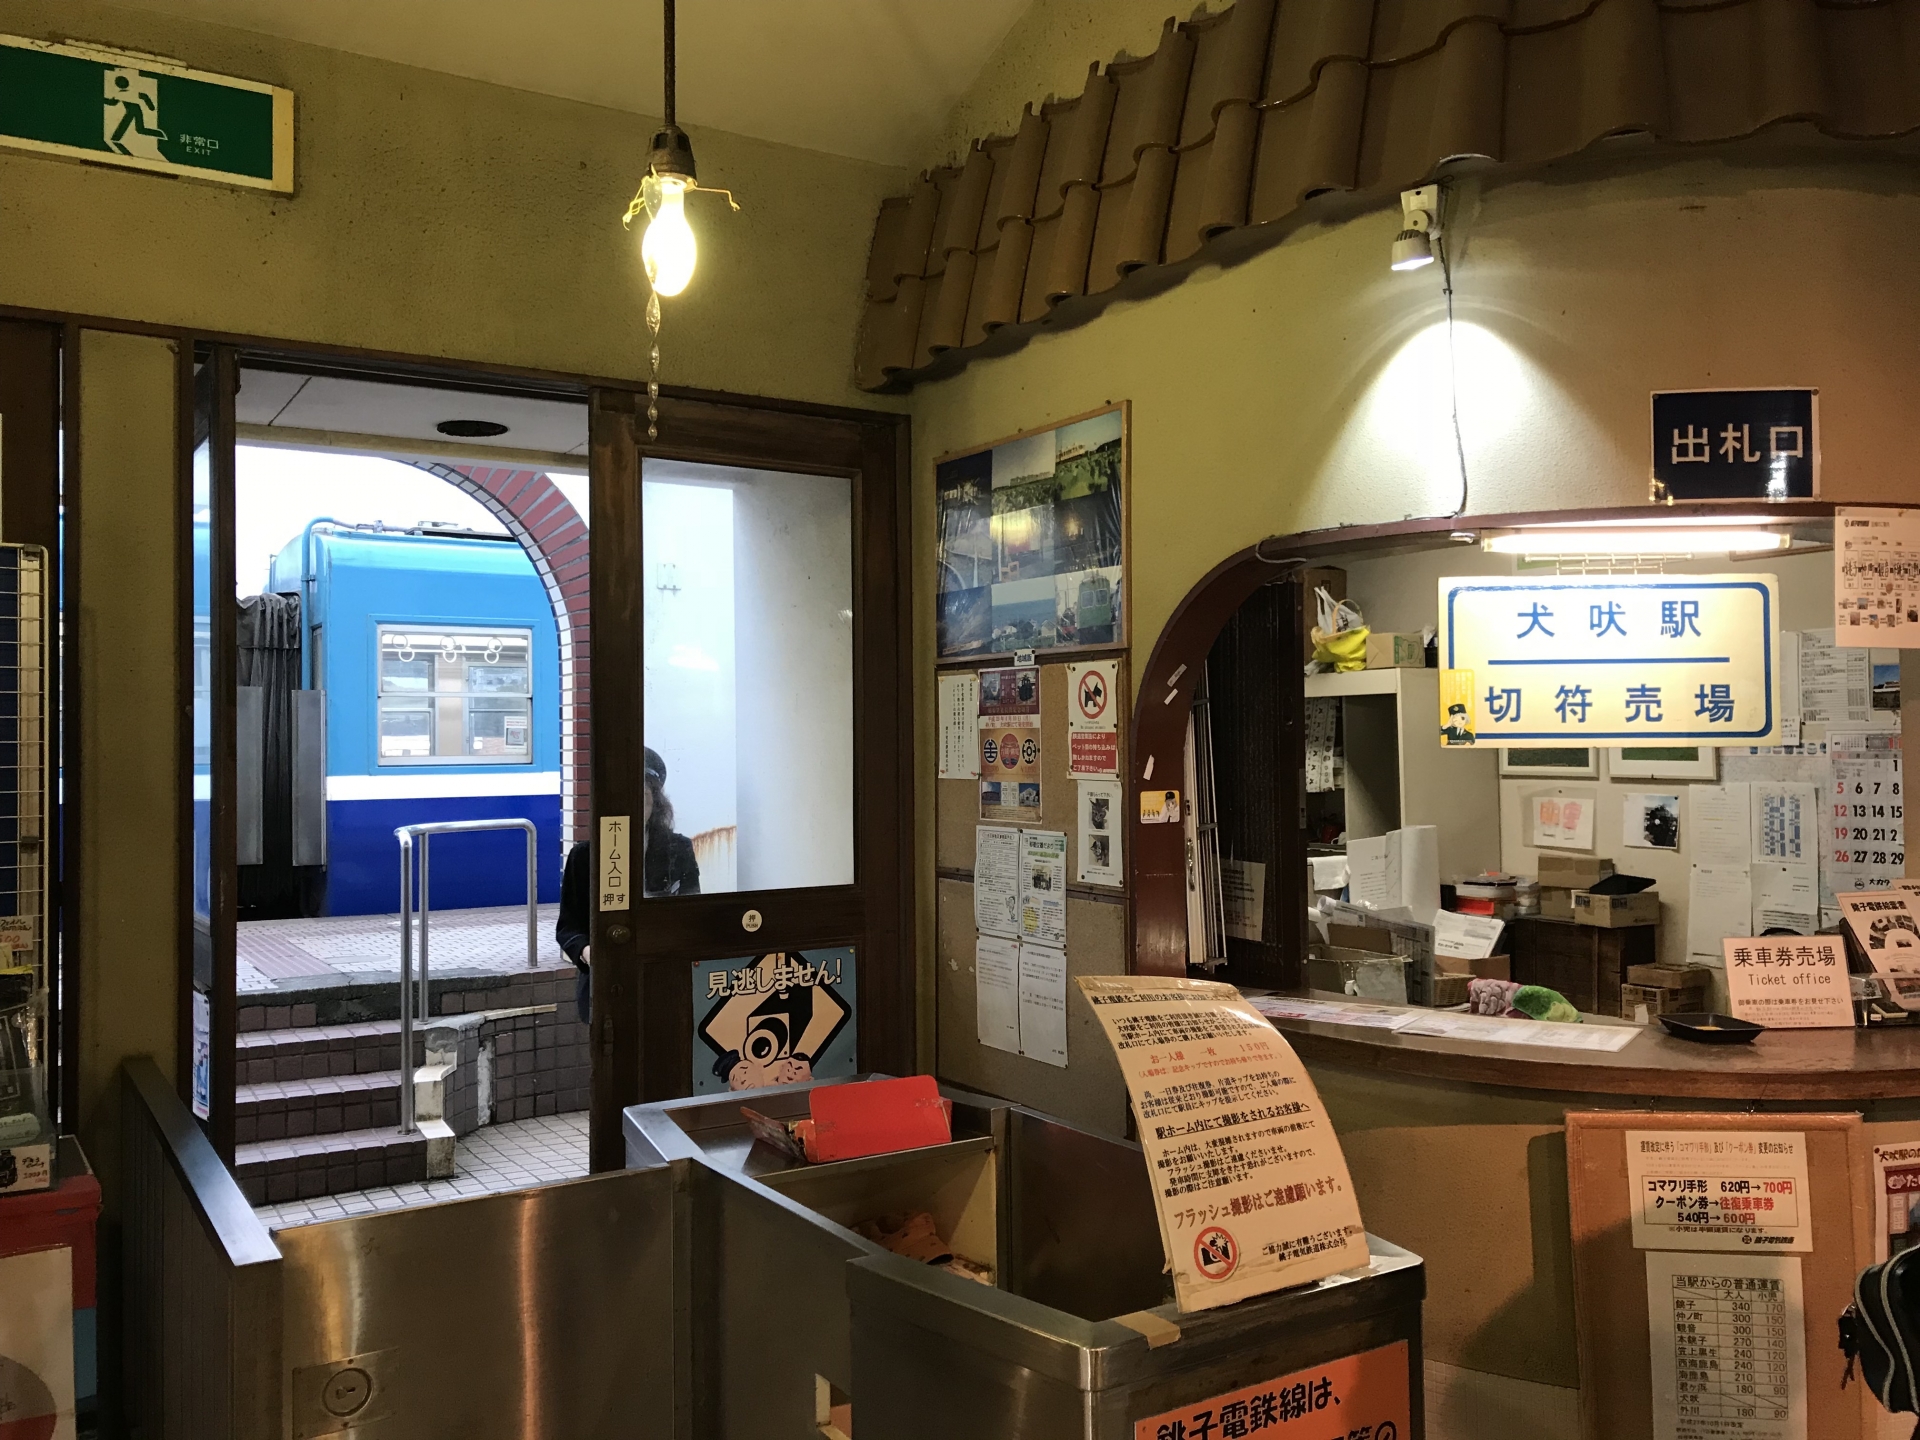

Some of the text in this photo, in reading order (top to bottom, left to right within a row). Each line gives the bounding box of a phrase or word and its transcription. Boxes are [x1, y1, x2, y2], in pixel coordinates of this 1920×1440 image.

[179, 134, 219, 149] 非常口
[186, 146, 212, 156] EXIT
[1671, 423, 1804, 464] 出札口
[1516, 601, 1702, 639] 犬吠駅
[1484, 684, 1735, 723] 切符売場
[1893, 759, 1898, 772] 1
[1836, 782, 1900, 795] 5 6 7 8
[1834, 804, 1903, 818] 12 13 14 15
[1834, 827, 1848, 839] 19
[1853, 828, 1868, 840] 20
[1872, 828, 1885, 841] 21
[608, 820, 623, 888] ホーム入口
[1834, 850, 1904, 865] 26 27 28 29
[602, 892, 626, 906] 押す
[748, 914, 757, 923] 押
[1733, 946, 1836, 967] 乗車券売場
[706, 958, 842, 999] 見逃しません!
[1748, 973, 1831, 986] Ticket office
[1150, 1041, 1270, 1065] お一人様 一枚 150円
[1155, 1101, 1311, 1140] 駅ホーム内にて撮影をされるお客様へ
[1879, 1148, 1920, 1162] 犬吠駅の
[1647, 1179, 1793, 1194] コマワリ手形 620円 700円
[1174, 1176, 1342, 1229] フラッシュ撮影はご遠慮願います。
[1655, 1195, 1774, 1211] クーポン券 往復乗車券
[1677, 1212, 1756, 1225] 540円 600円
[1676, 1276, 1781, 1292] 当駅からの普通運賃
[1724, 1290, 1744, 1300] 大人
[1732, 1302, 1750, 1311] 340
[1765, 1304, 1783, 1312] 170
[1732, 1314, 1750, 1323] 300
[1766, 1316, 1783, 1324] 150
[1733, 1326, 1751, 1335] 300
[1766, 1327, 1784, 1336] 150
[1733, 1338, 1751, 1347] 270
[1766, 1339, 1784, 1348] 140
[1734, 1350, 1752, 1358] 240
[1767, 1351, 1784, 1360] 120
[1734, 1361, 1752, 1370] 240
[1767, 1363, 1785, 1372] 120
[1734, 1373, 1753, 1382] 210
[1768, 1375, 1785, 1384] 110
[1736, 1385, 1753, 1394] 180
[1773, 1386, 1786, 1395] 90
[1736, 1408, 1754, 1417] 180
[1774, 1409, 1786, 1418] 90
